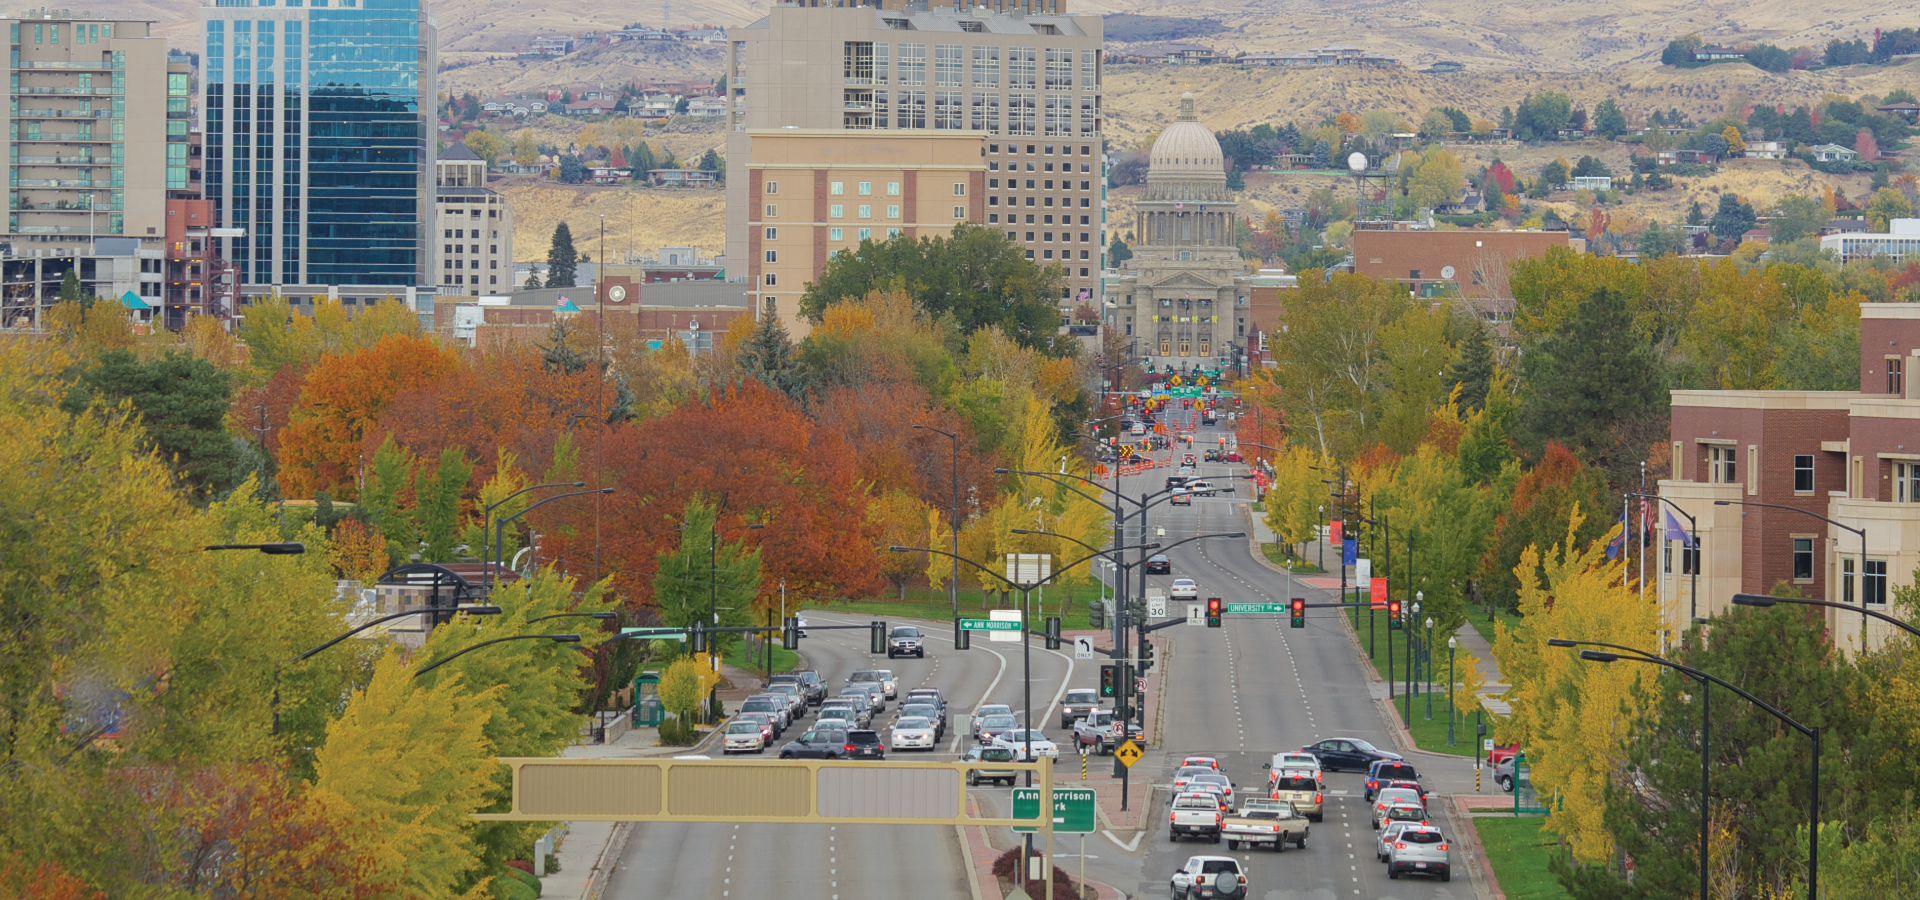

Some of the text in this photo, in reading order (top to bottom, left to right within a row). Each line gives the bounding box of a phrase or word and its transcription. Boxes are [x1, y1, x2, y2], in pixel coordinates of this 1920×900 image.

[1230, 604, 1265, 612] UNIVERSITY
[974, 621, 984, 629] ANN
[986, 621, 1011, 629] MORRISON
[1018, 791, 1091, 800] Ann orrison
